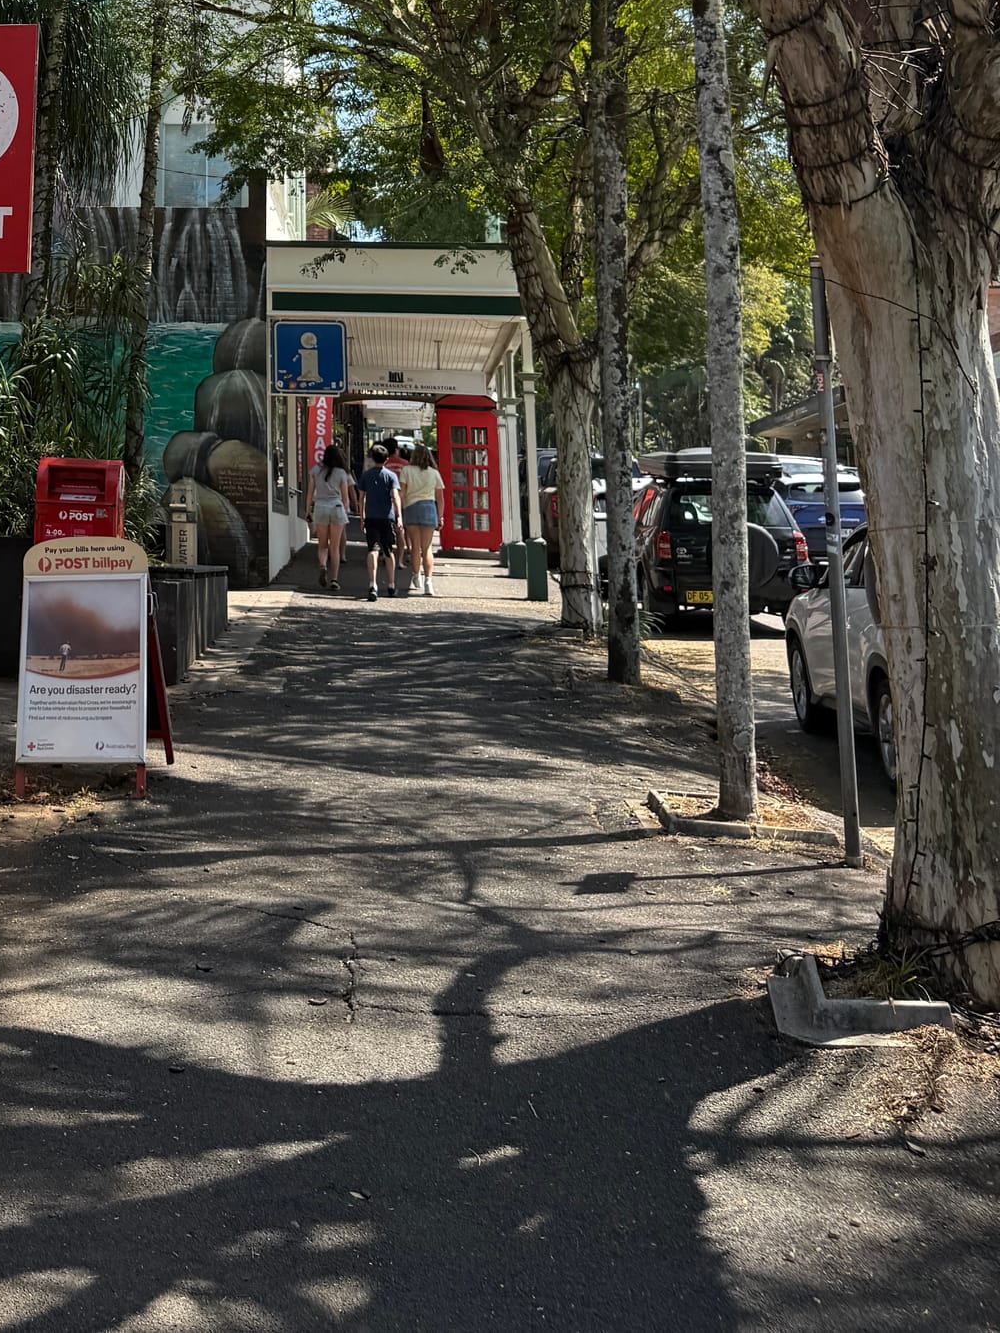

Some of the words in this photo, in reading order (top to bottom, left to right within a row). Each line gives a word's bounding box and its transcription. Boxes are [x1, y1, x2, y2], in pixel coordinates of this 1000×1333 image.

[69, 512, 94, 522] POST
[44, 546, 57, 555] Pay
[58, 547, 74, 555] your
[106, 544, 126, 553] using
[55, 557, 90, 570] POST
[92, 556, 134, 571] billpay
[29, 684, 47, 695] Are
[48, 686, 65, 697] you
[66, 684, 104, 695] disaster
[104, 683, 137, 696] ready?
